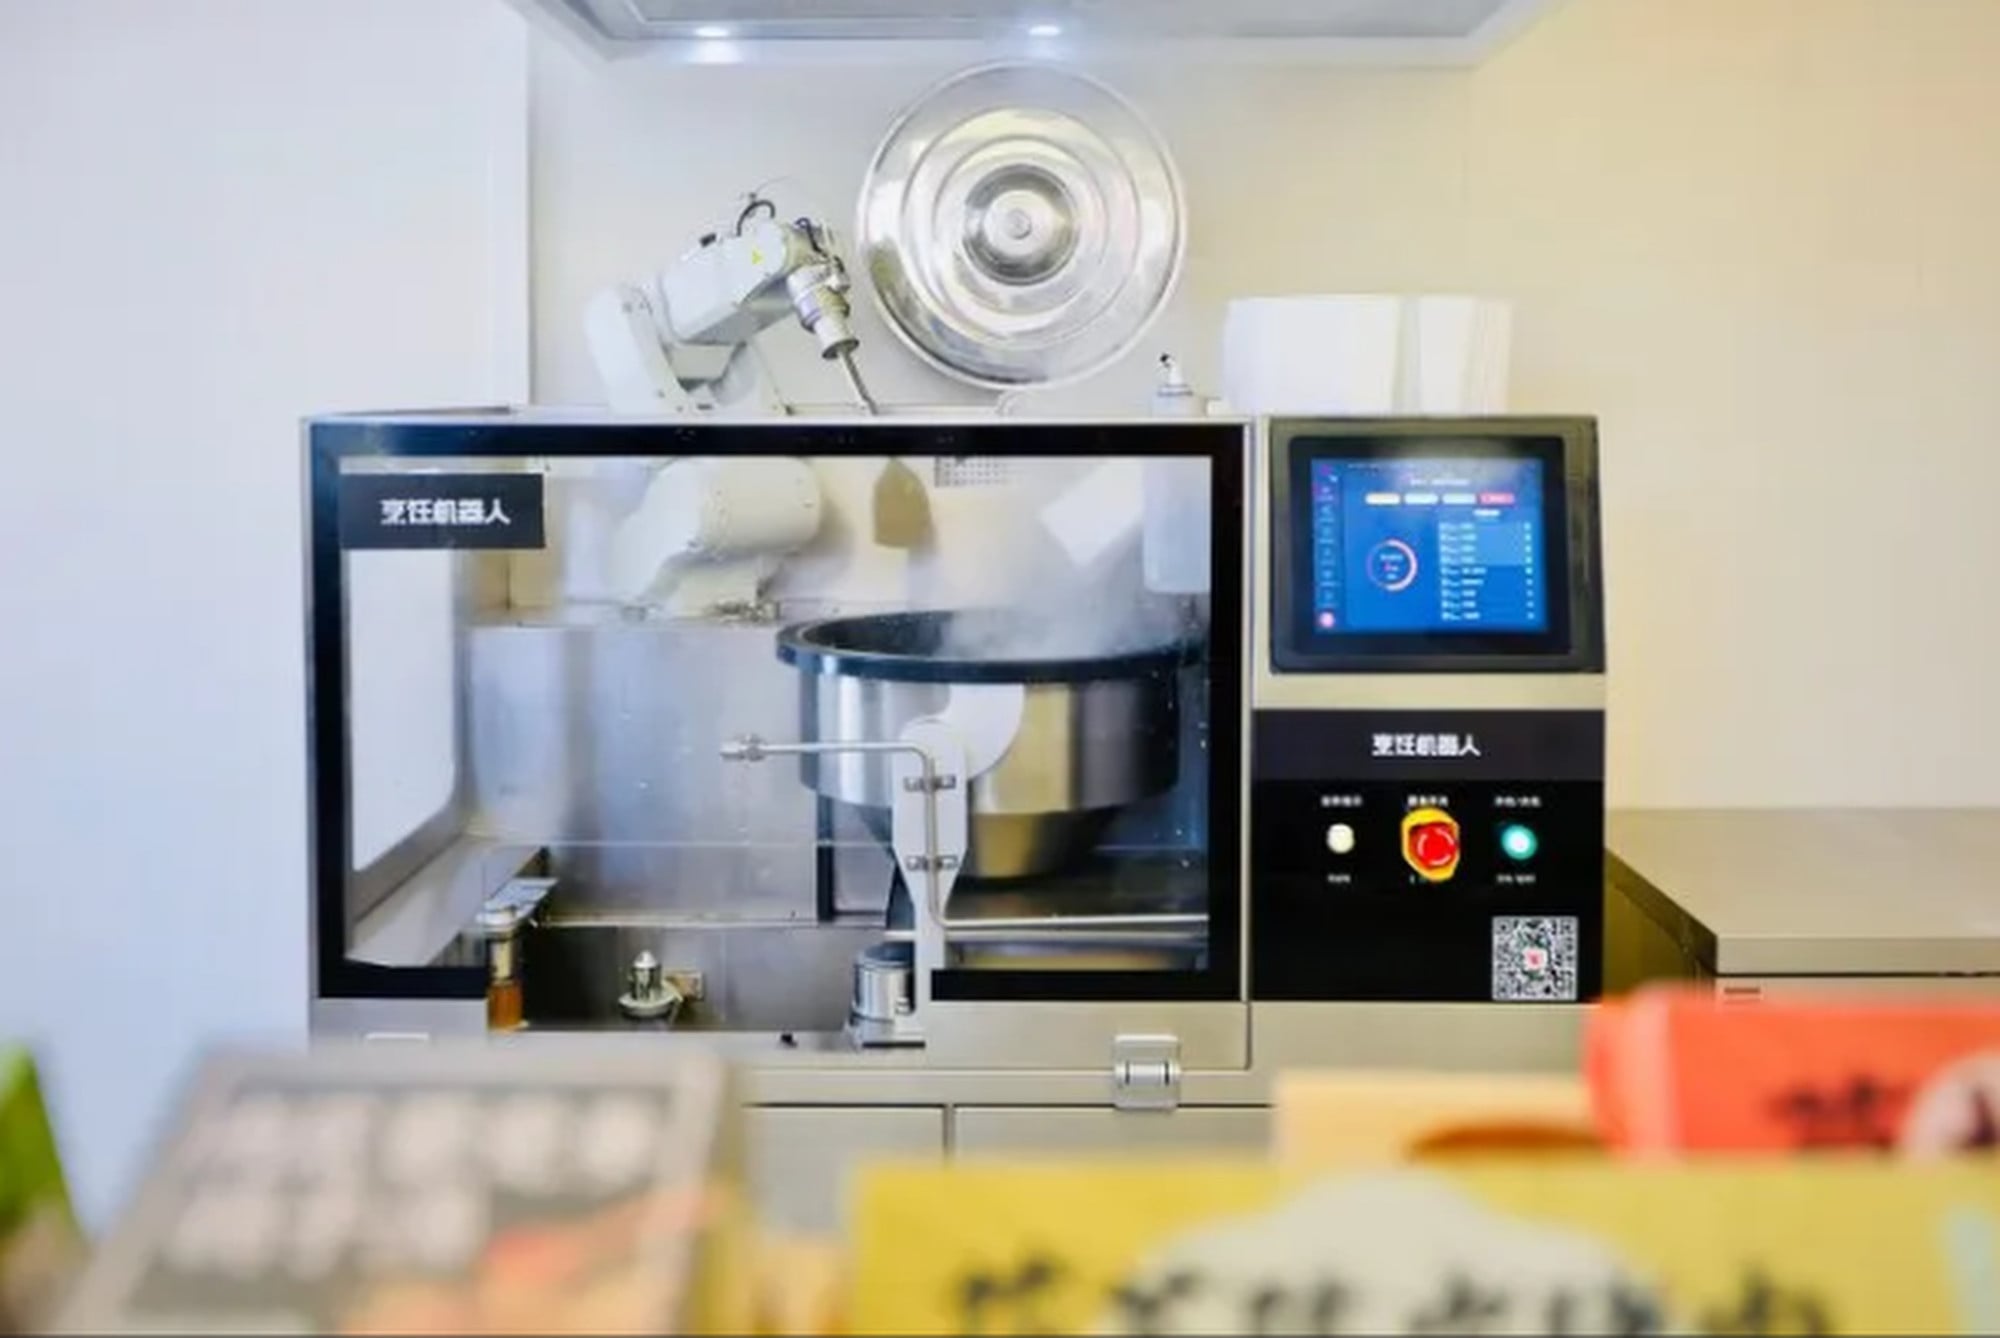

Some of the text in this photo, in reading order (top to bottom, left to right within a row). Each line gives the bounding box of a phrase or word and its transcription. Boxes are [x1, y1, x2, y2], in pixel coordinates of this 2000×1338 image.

[380, 498, 511, 526] 烹饪机器人
[1371, 732, 1482, 757] 烹饪机器人
